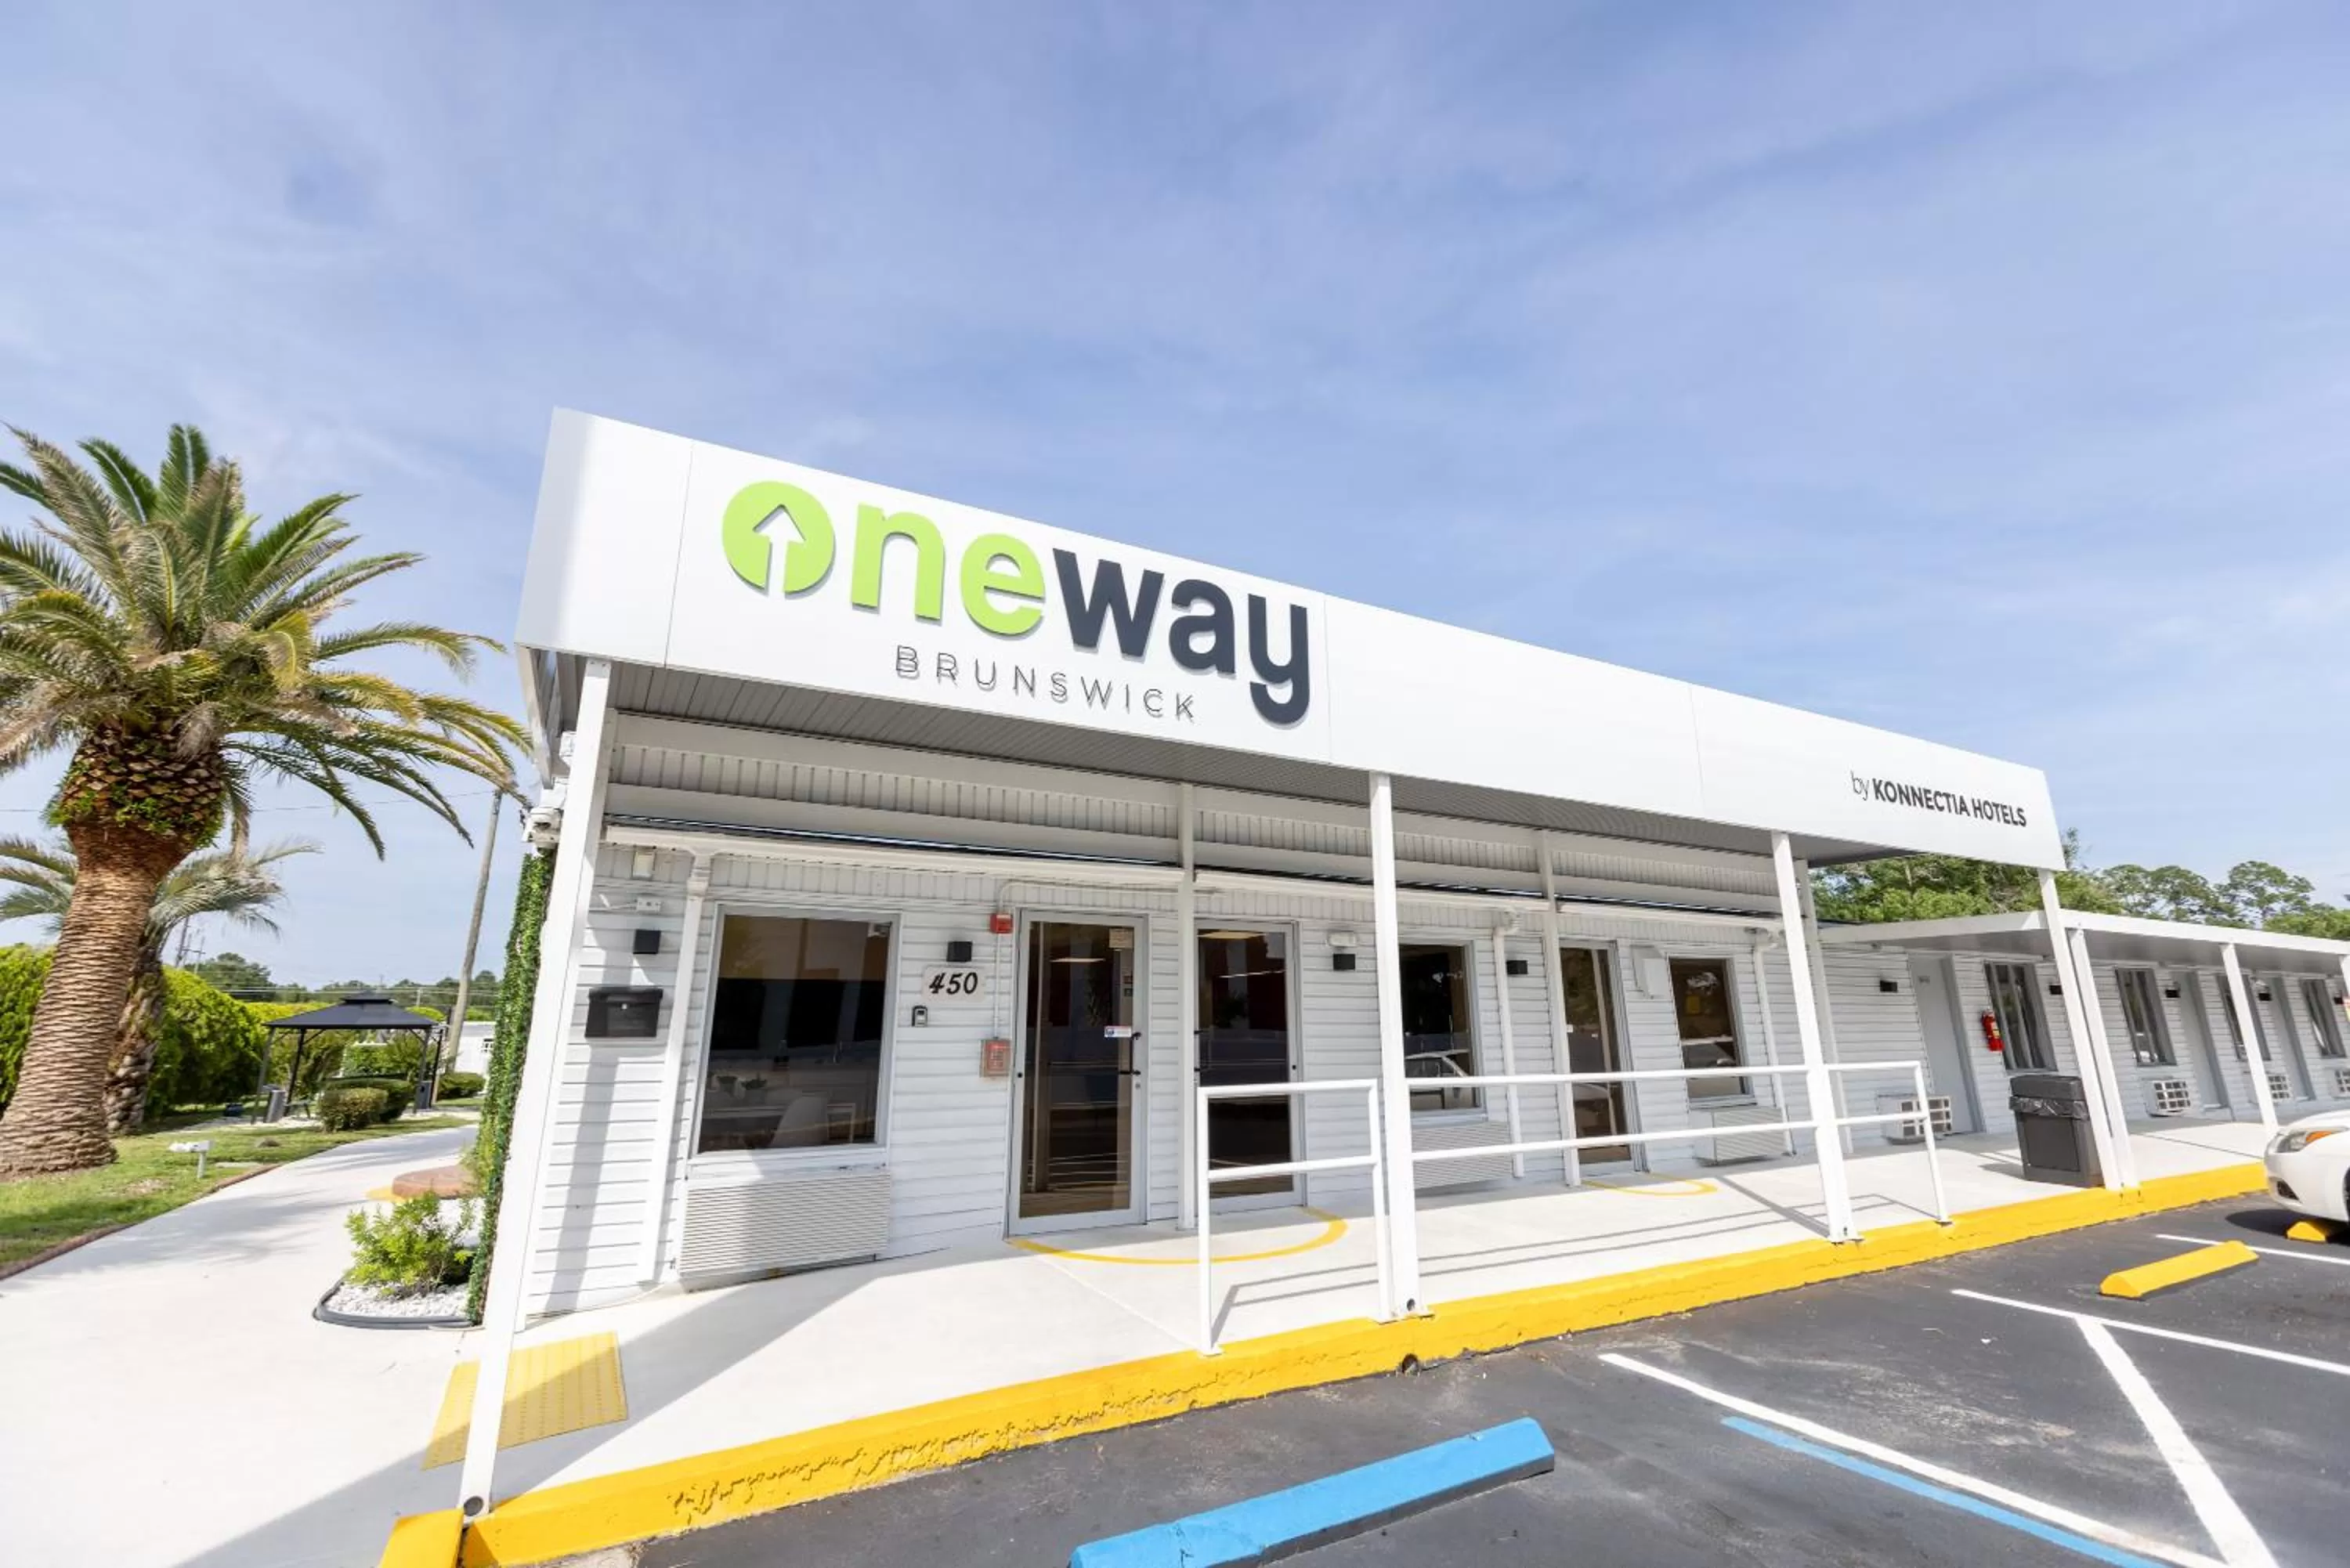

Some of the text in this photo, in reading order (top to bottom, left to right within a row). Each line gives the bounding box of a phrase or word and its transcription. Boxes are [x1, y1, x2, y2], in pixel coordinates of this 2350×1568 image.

[895, 645, 1198, 721] BRUNSWICK
[1850, 770, 2027, 827] by KONNECTIA HOTELS
[928, 972, 978, 995] 450
